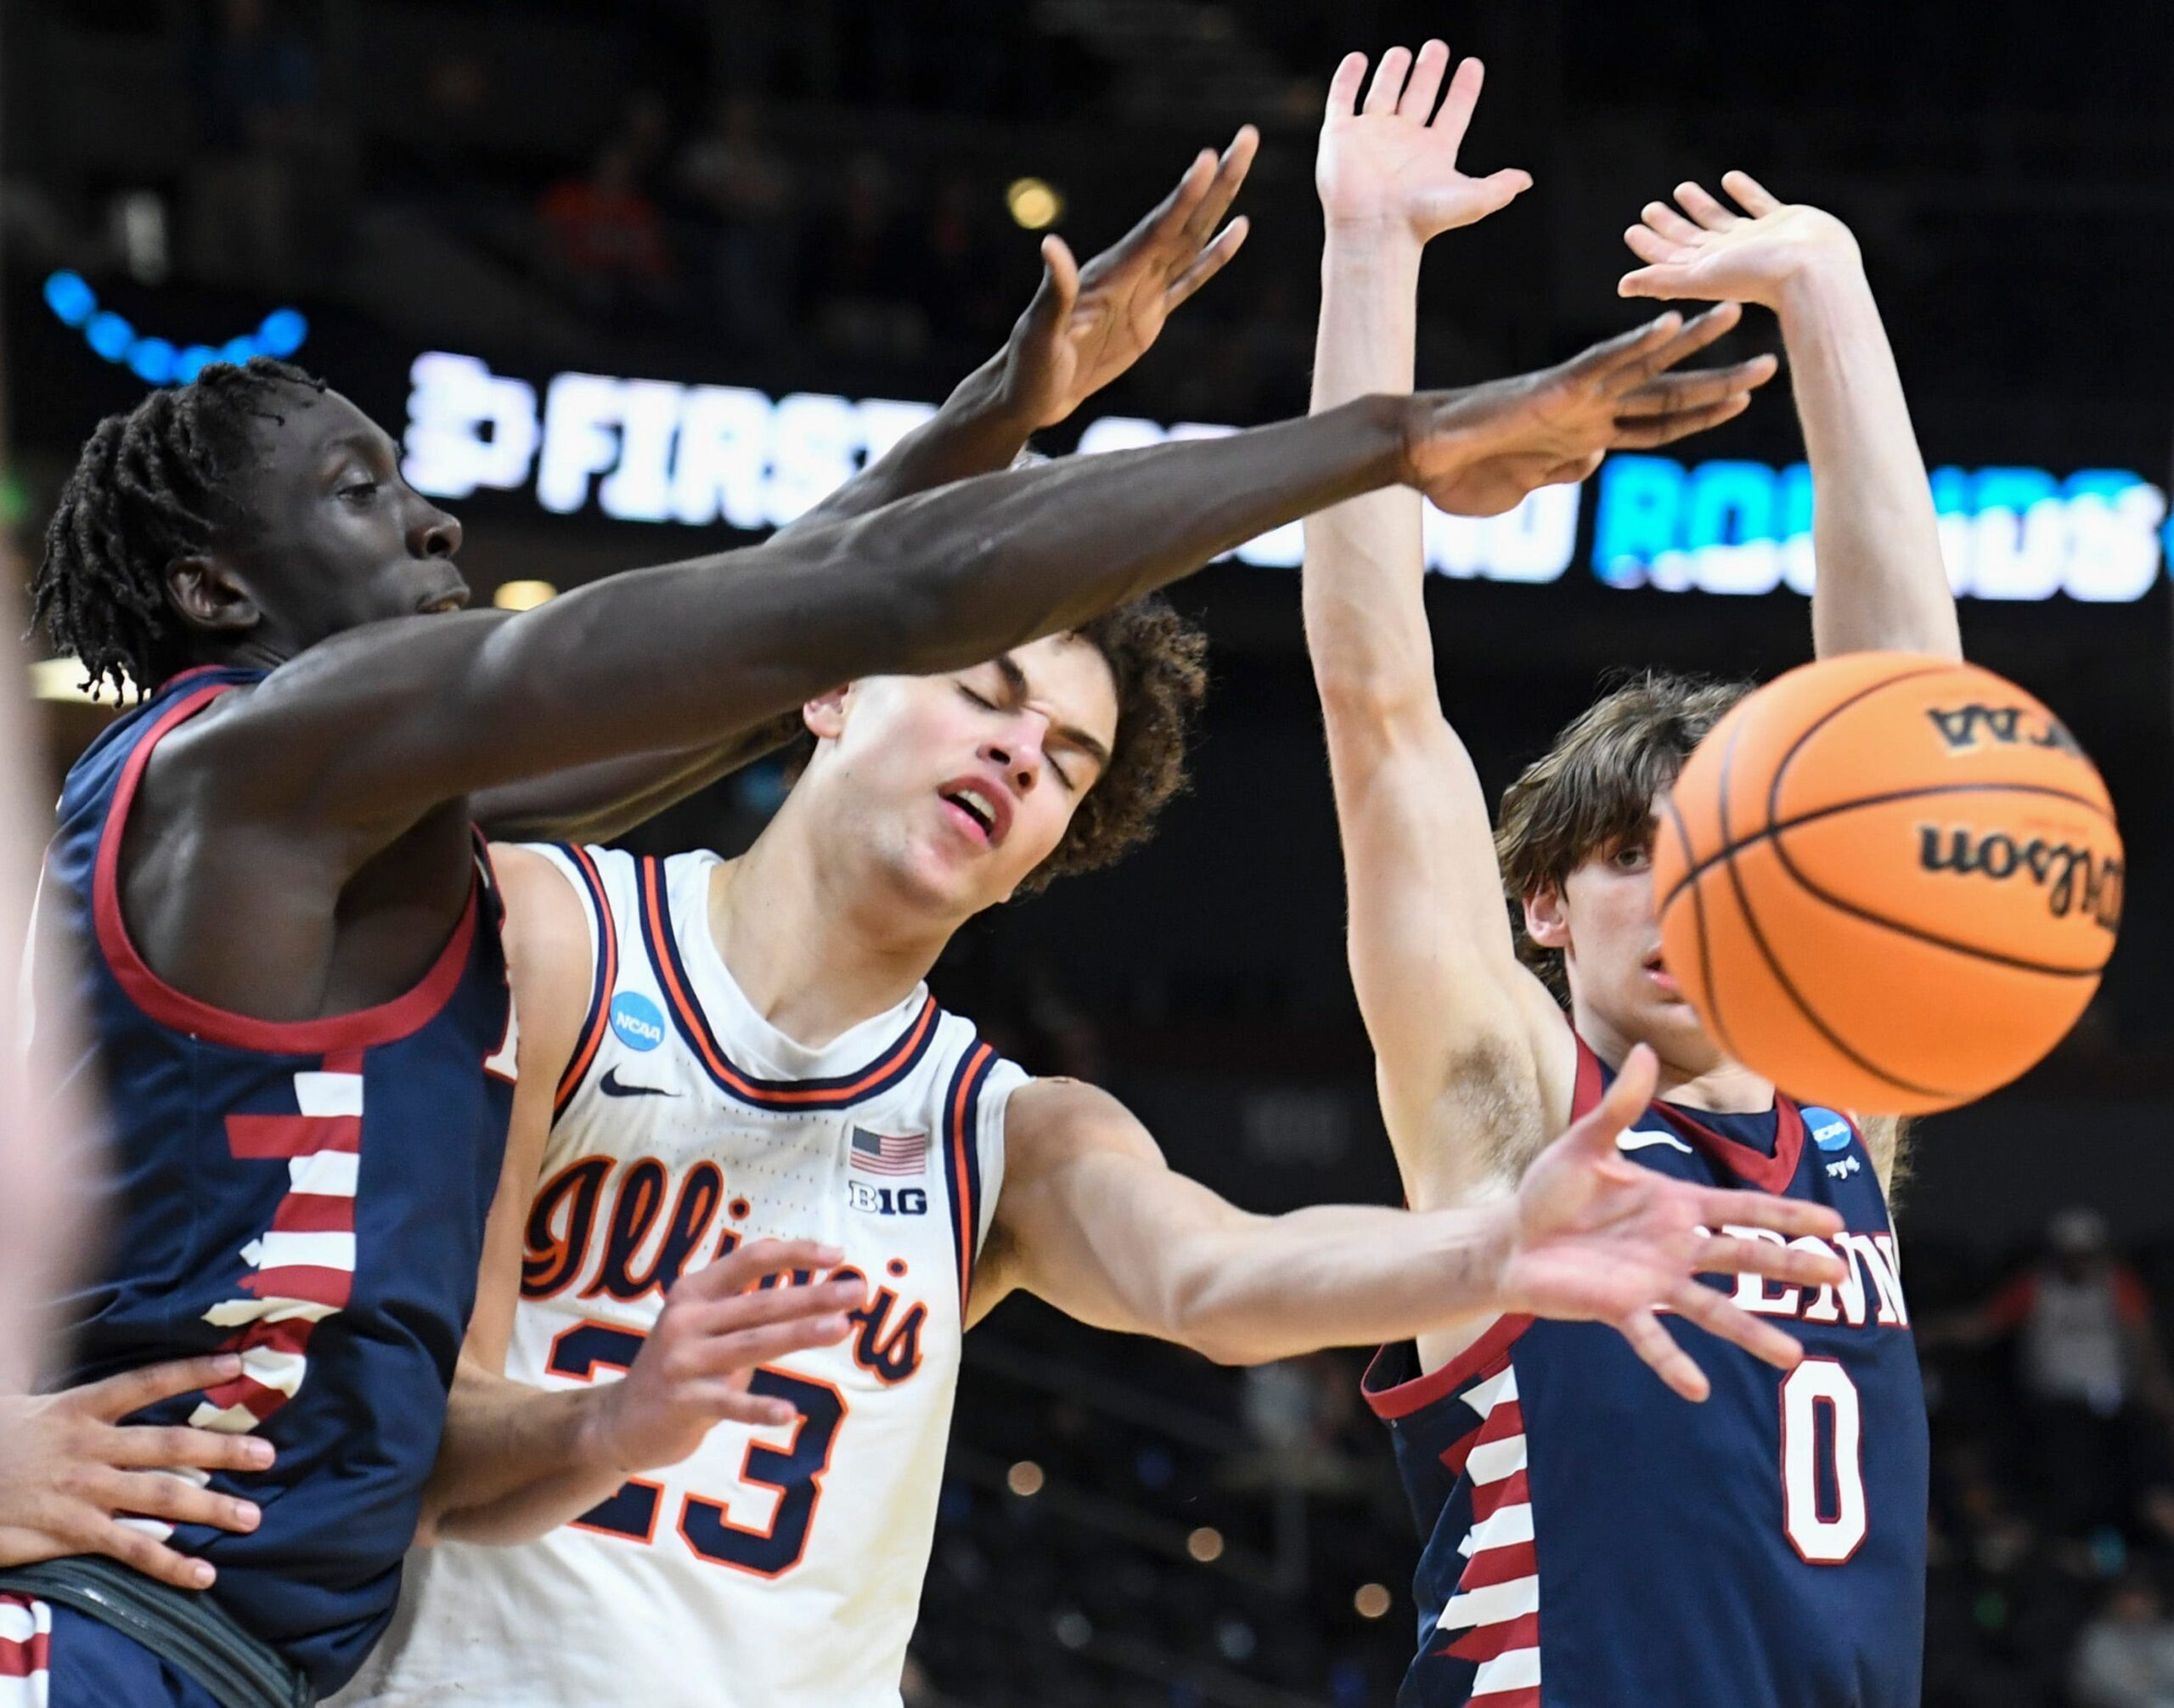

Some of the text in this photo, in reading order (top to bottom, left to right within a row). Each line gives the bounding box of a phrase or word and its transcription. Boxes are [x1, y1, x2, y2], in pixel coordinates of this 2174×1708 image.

[616, 1011, 662, 1043] NCAA
[1650, 1223, 1909, 1329] ENN
[1779, 1356, 1868, 1564] 0
